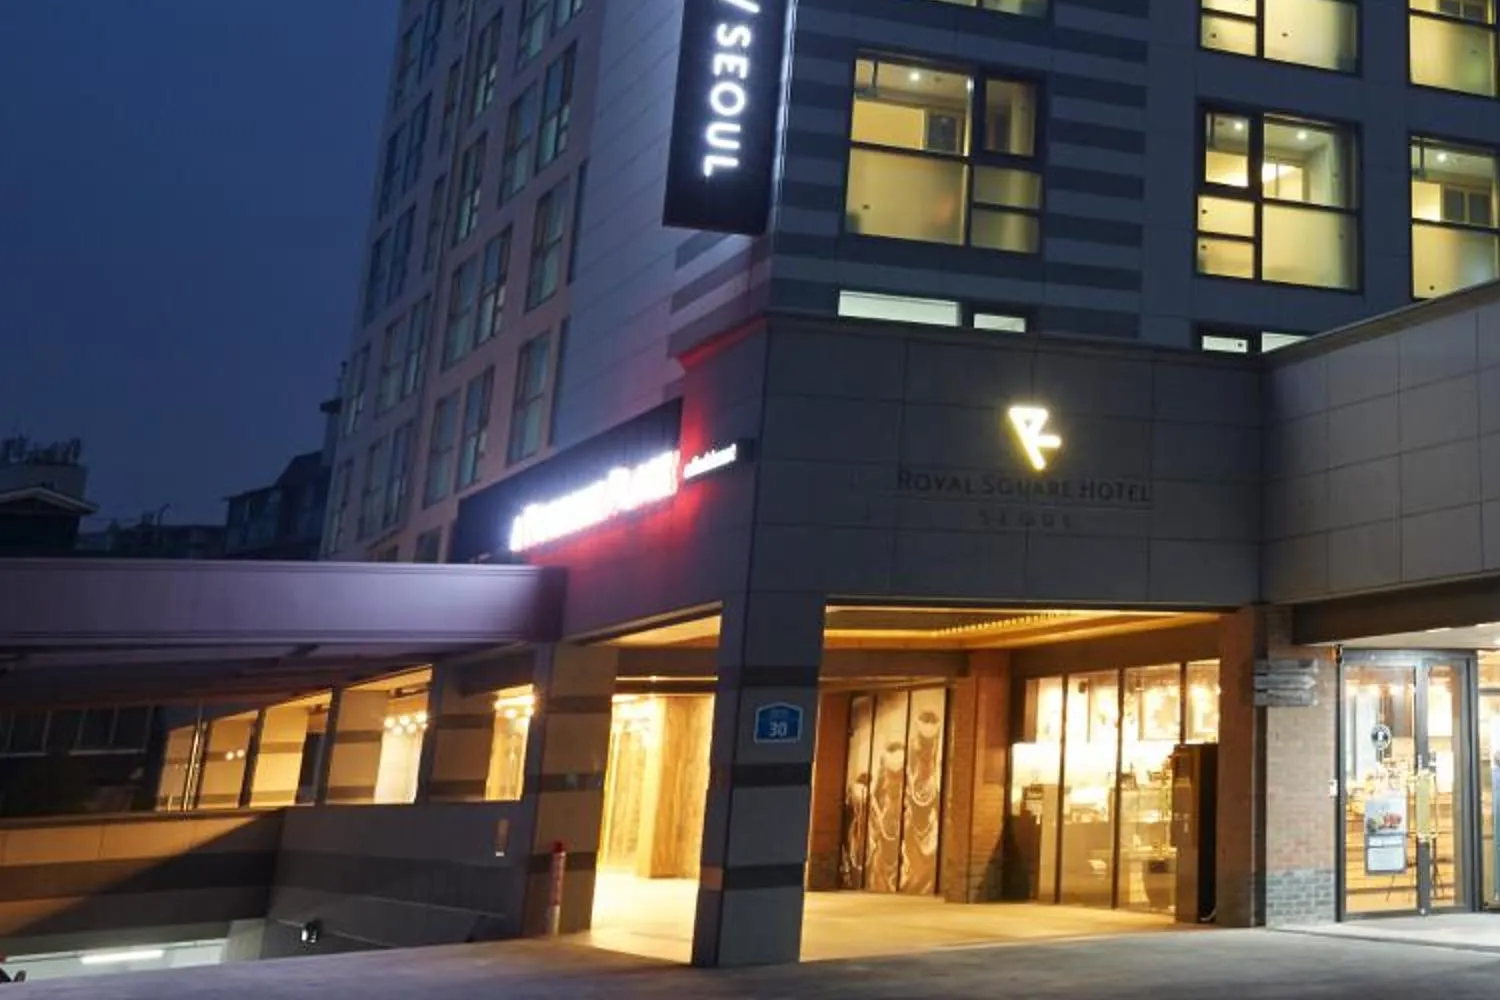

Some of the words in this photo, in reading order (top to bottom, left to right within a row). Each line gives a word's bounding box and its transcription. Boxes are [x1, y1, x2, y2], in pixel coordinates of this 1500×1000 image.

[897, 469, 974, 496] ROYAL
[978, 475, 1073, 499] SQUARE
[1077, 479, 1152, 503] HOTEL
[769, 721, 788, 737] 30
